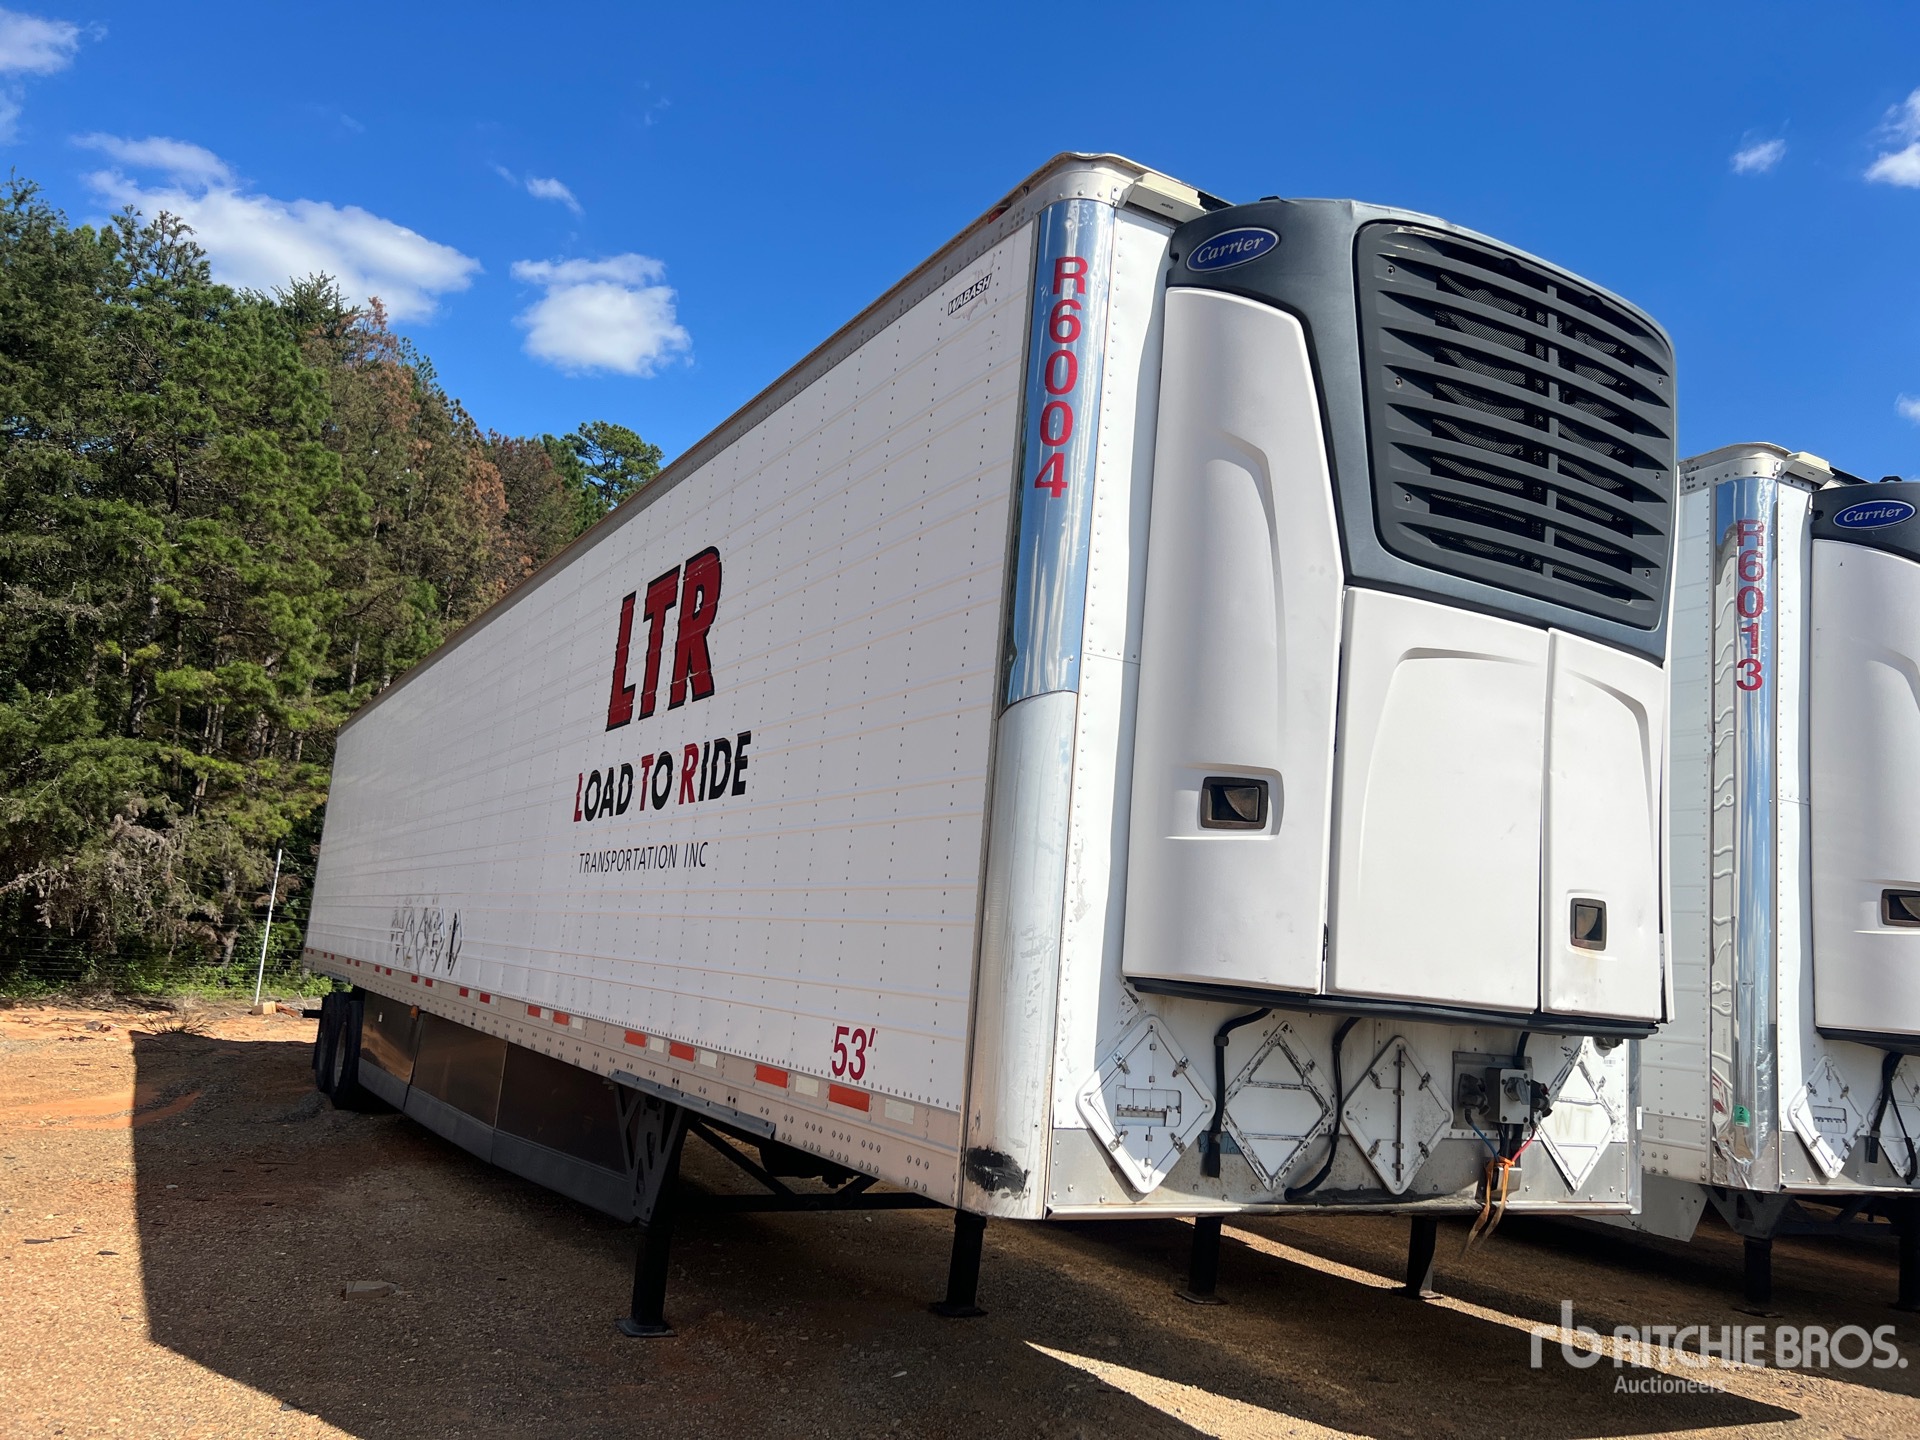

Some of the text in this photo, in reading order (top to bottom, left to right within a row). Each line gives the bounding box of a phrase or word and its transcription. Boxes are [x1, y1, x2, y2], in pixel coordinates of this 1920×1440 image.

[1196, 235, 1265, 264] Carrier
[949, 274, 991, 315] WABASH
[1034, 256, 1089, 498] R6004
[1843, 506, 1904, 523] Carrier
[1736, 519, 1765, 691] R6013
[605, 546, 722, 732] LTR
[573, 730, 751, 822] LOAD TO RIDE
[579, 842, 708, 873] TRANSPORTATION INC
[831, 1026, 876, 1080] 53'
